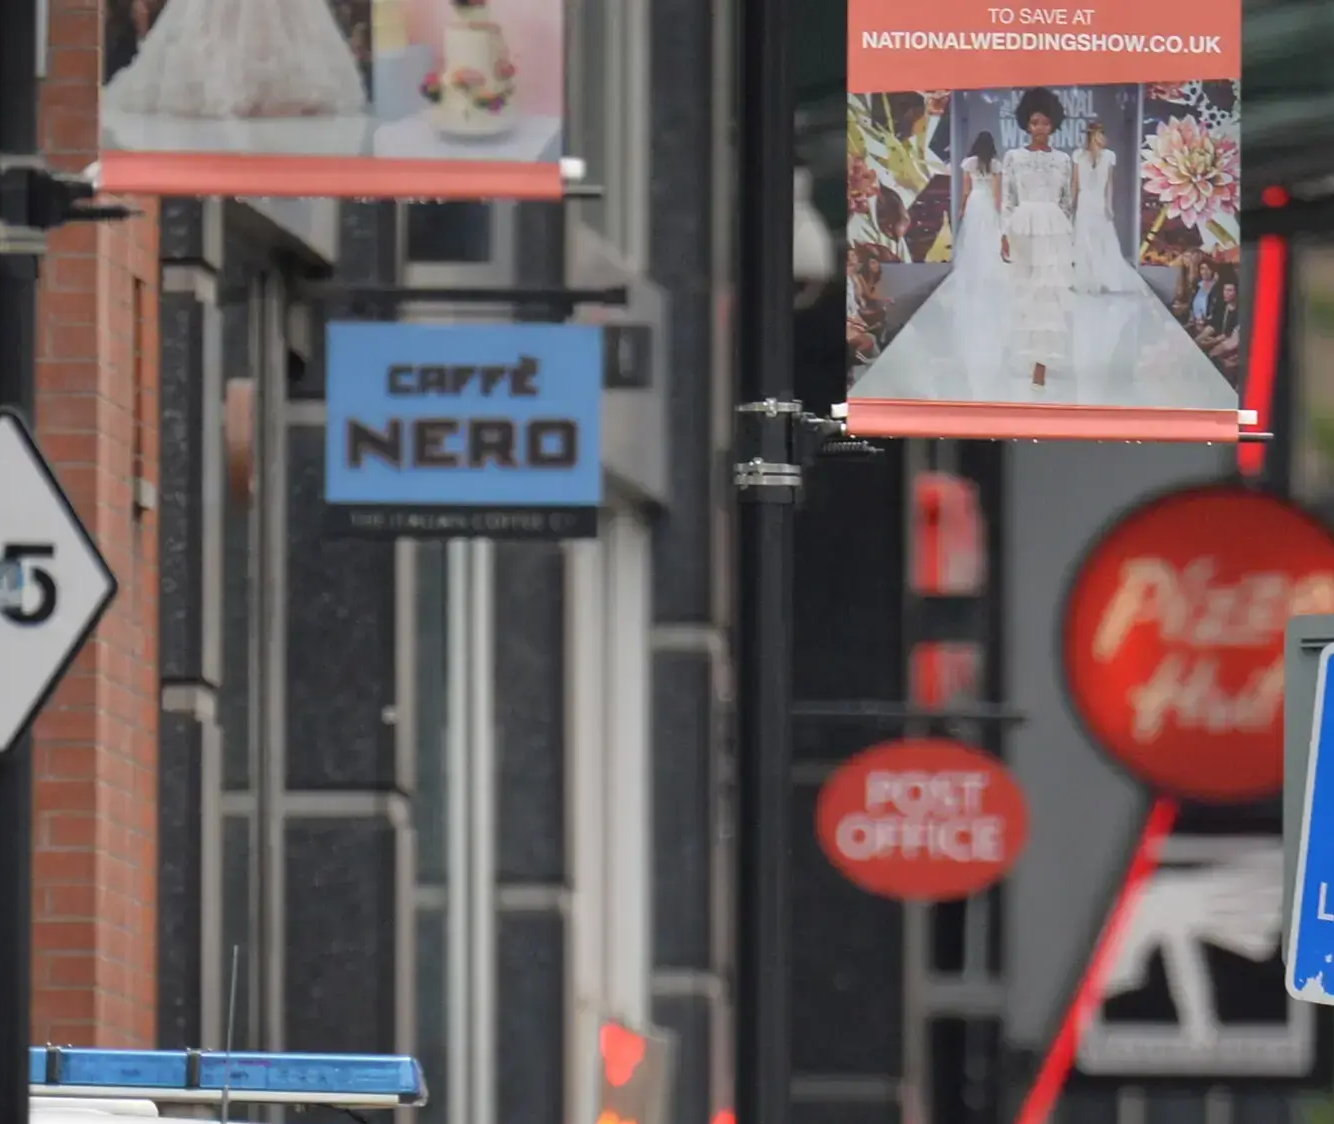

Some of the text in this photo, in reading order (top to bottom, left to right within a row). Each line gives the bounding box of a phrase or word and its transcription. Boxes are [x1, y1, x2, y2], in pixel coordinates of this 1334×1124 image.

[987, 8, 1095, 26] TO SAVE AT
[862, 31, 1221, 54] NATIONALWEDDINGSHOW.CO.UK
[346, 417, 579, 472] NERO
[865, 770, 990, 815] POST
[835, 813, 1006, 862] OFFICE
